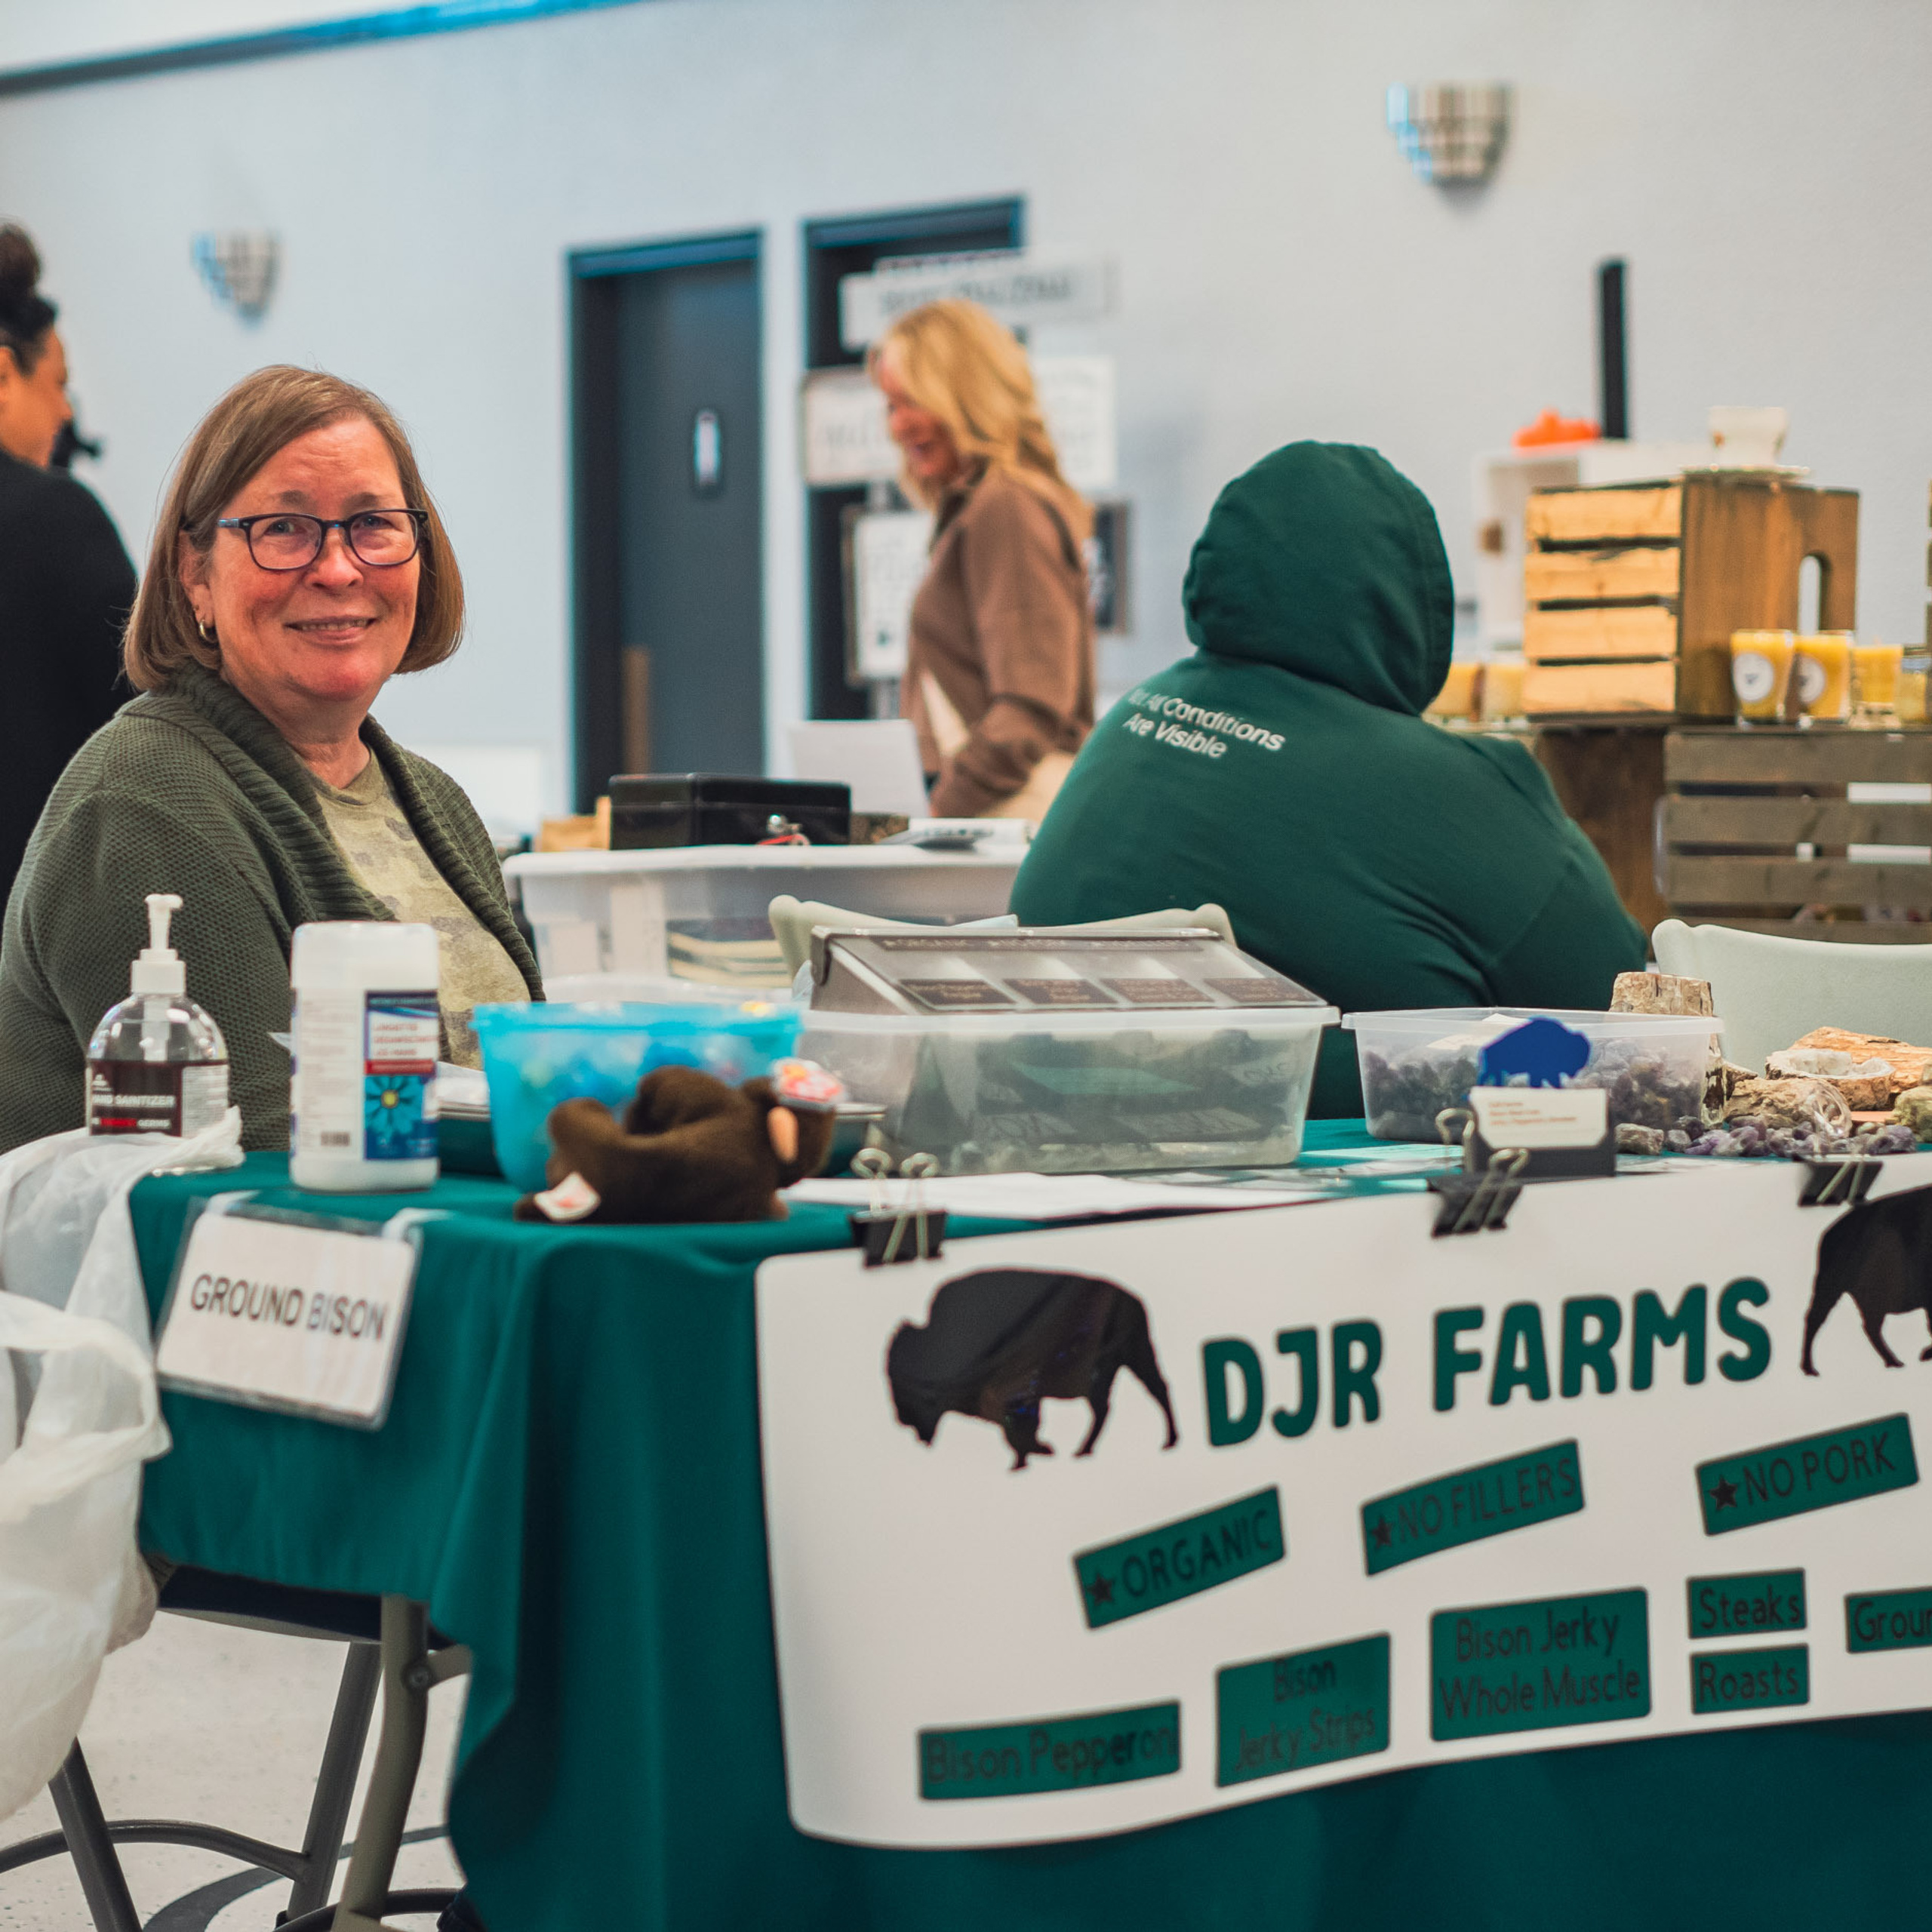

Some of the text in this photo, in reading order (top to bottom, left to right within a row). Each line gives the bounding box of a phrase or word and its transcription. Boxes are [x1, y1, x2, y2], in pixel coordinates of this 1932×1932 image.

[1123, 712, 1228, 758] Are Visible
[1163, 697, 1286, 752] Conditions
[115, 1095, 175, 1108] SANITIZER
[191, 1274, 389, 1340] GROUND BISON
[1201, 1276, 1771, 1447] DJR FARMS
[1742, 1432, 1895, 1506] NO PORK
[1398, 1458, 1577, 1544] NO FILLERS
[1121, 1509, 1272, 1598] ORGANIC
[1455, 1604, 1619, 1662] Bison Jerky
[1700, 1584, 1801, 1630] Steaks
[1274, 1659, 1336, 1702] Bison
[1439, 1660, 1640, 1720] Whole Muscle
[1699, 1660, 1799, 1705] Roasts
[926, 1736, 1022, 1783] Bison
[1235, 1703, 1375, 1771] Jerky Strips
